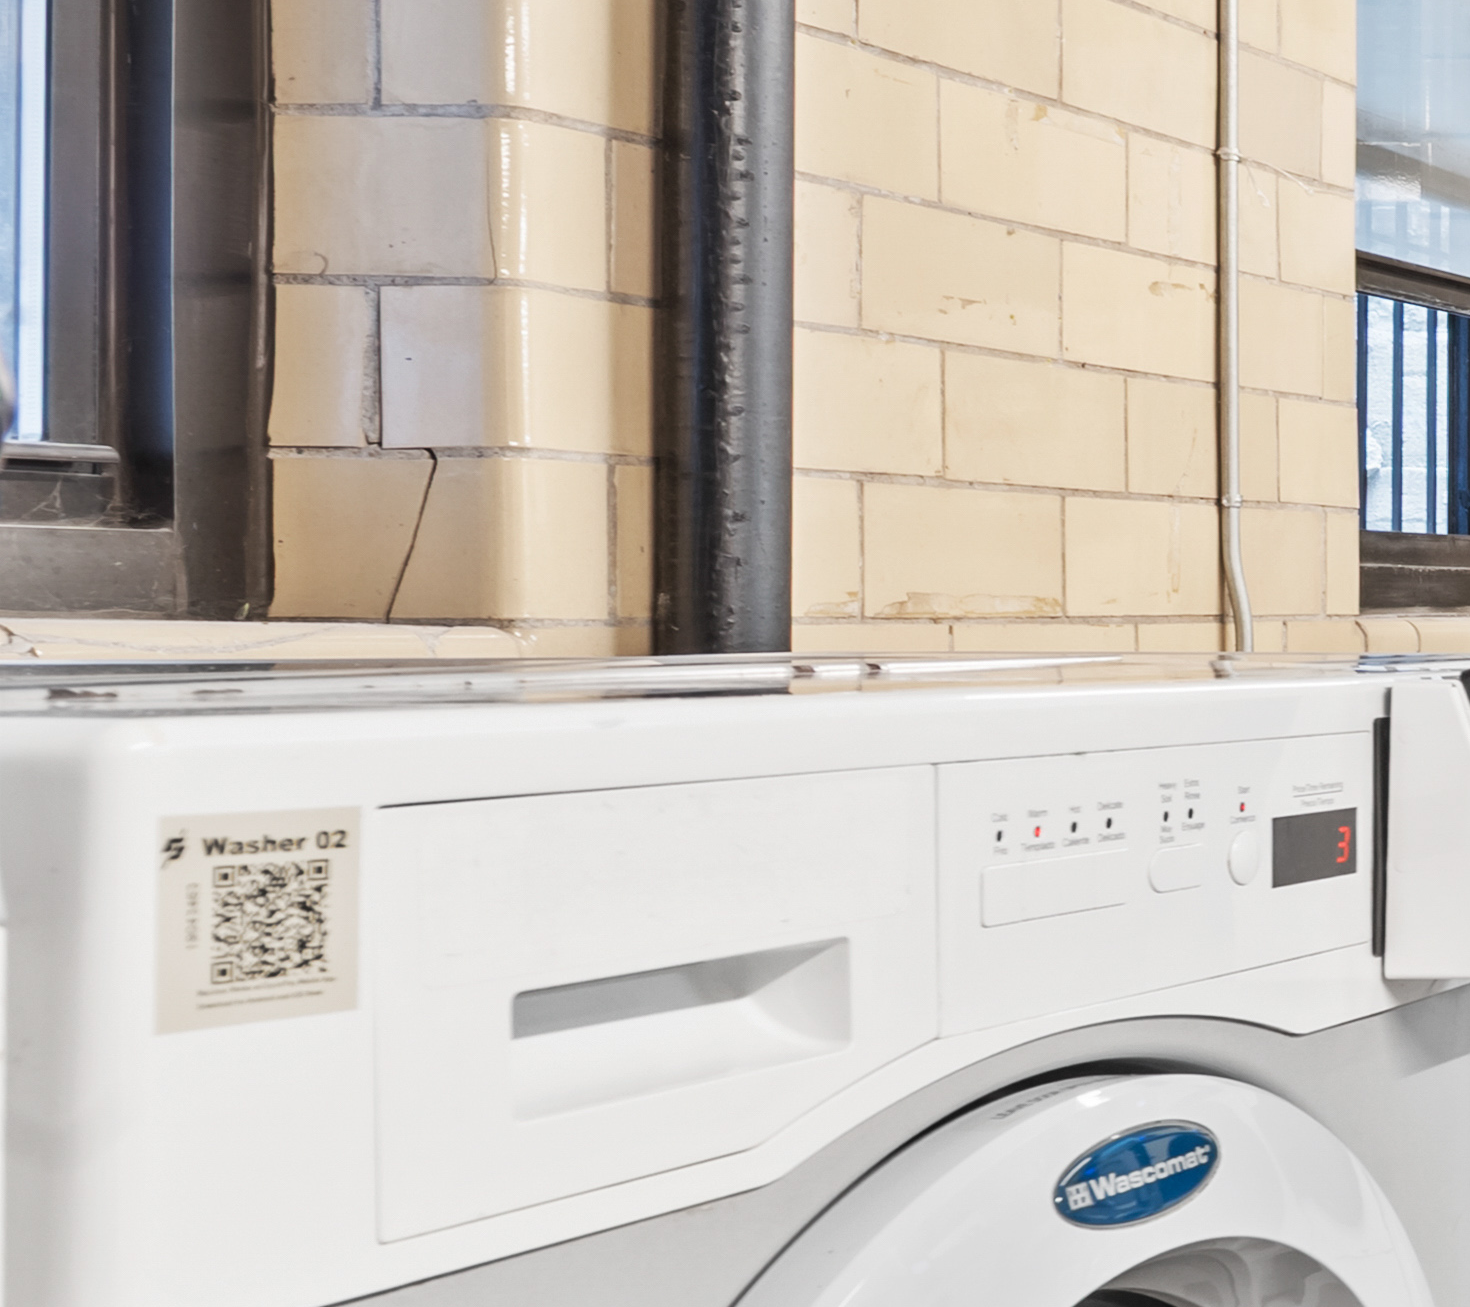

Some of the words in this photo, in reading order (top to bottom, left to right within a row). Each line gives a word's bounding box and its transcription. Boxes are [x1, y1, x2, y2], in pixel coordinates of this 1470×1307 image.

[201, 834, 307, 856] Washer
[315, 829, 348, 850] 02
[1335, 824, 1352, 864] 3
